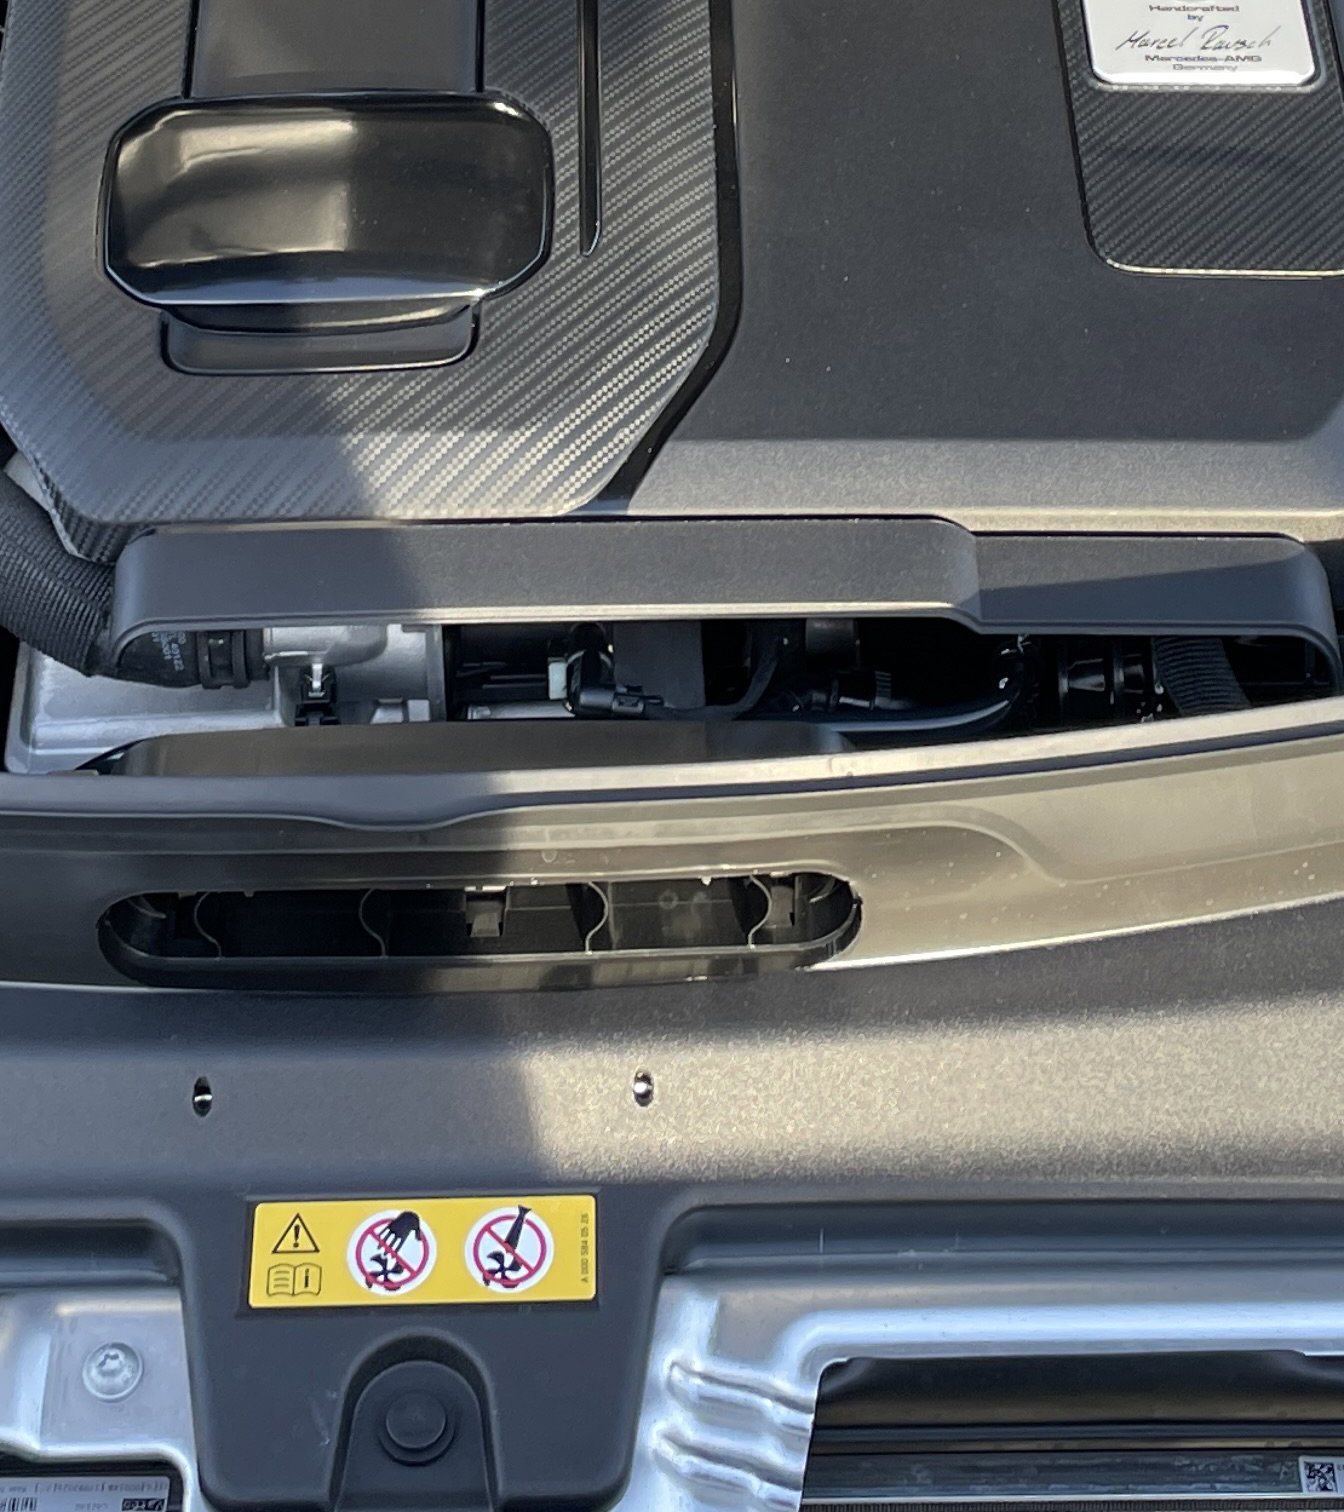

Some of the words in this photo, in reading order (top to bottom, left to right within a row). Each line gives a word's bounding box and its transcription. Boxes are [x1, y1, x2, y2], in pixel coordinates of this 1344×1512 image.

[1149, 4, 1240, 12] Handcrafted
[1187, 13, 1204, 23] by
[1115, 26, 1199, 51] Marcel
[1144, 54, 1263, 63] Mercedes-AMG
[1172, 63, 1239, 72] Germany
